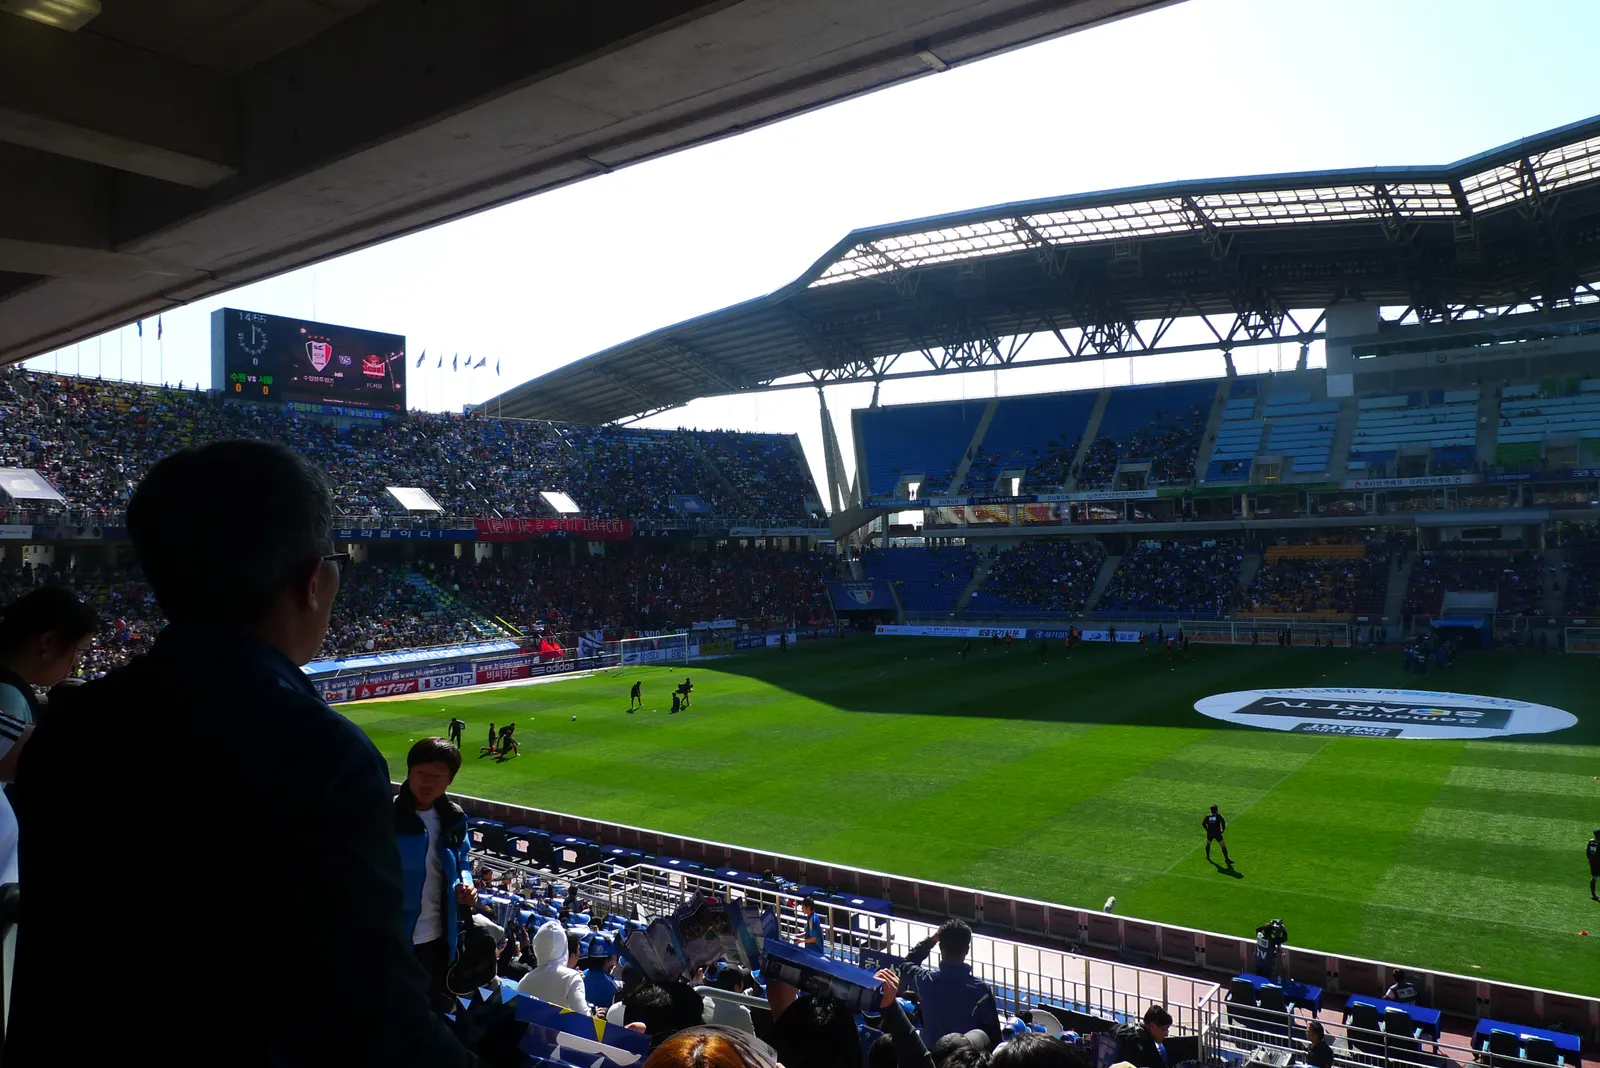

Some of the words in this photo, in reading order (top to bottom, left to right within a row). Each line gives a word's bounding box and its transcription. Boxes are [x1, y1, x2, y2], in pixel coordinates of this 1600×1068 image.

[235, 383, 242, 392] 0
[262, 386, 269, 395] 0
[546, 662, 574, 673] adidas
[434, 673, 473, 688] 장인가구
[1262, 701, 1312, 709] TV
[1337, 711, 1479, 724] Samsung
